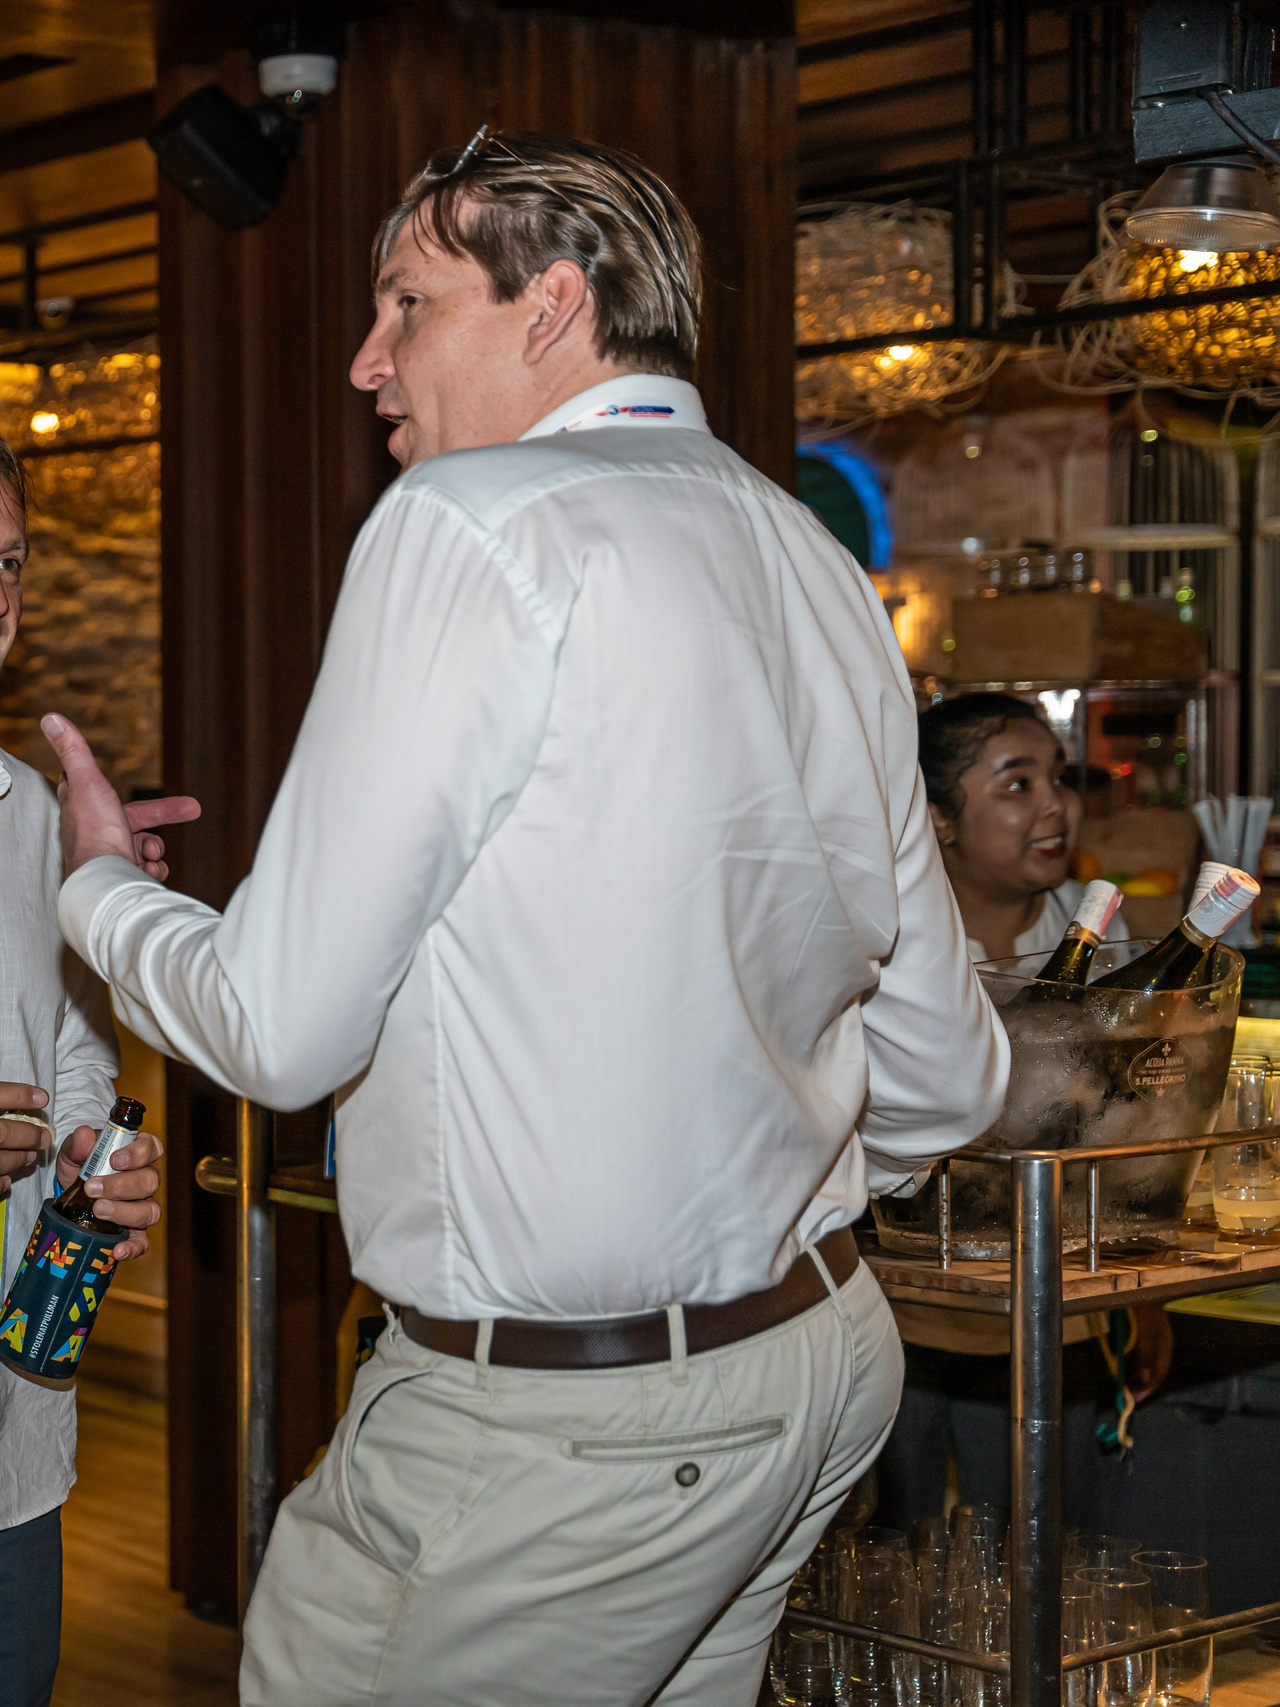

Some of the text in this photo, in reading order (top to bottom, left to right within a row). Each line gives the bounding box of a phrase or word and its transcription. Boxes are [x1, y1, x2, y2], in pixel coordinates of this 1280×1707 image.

[1145, 1057, 1164, 1068] ACQUA
[1135, 1074, 1186, 1086] S.PELLEGRINO
[29, 1294, 60, 1359] #STOLENATPULLMAN
